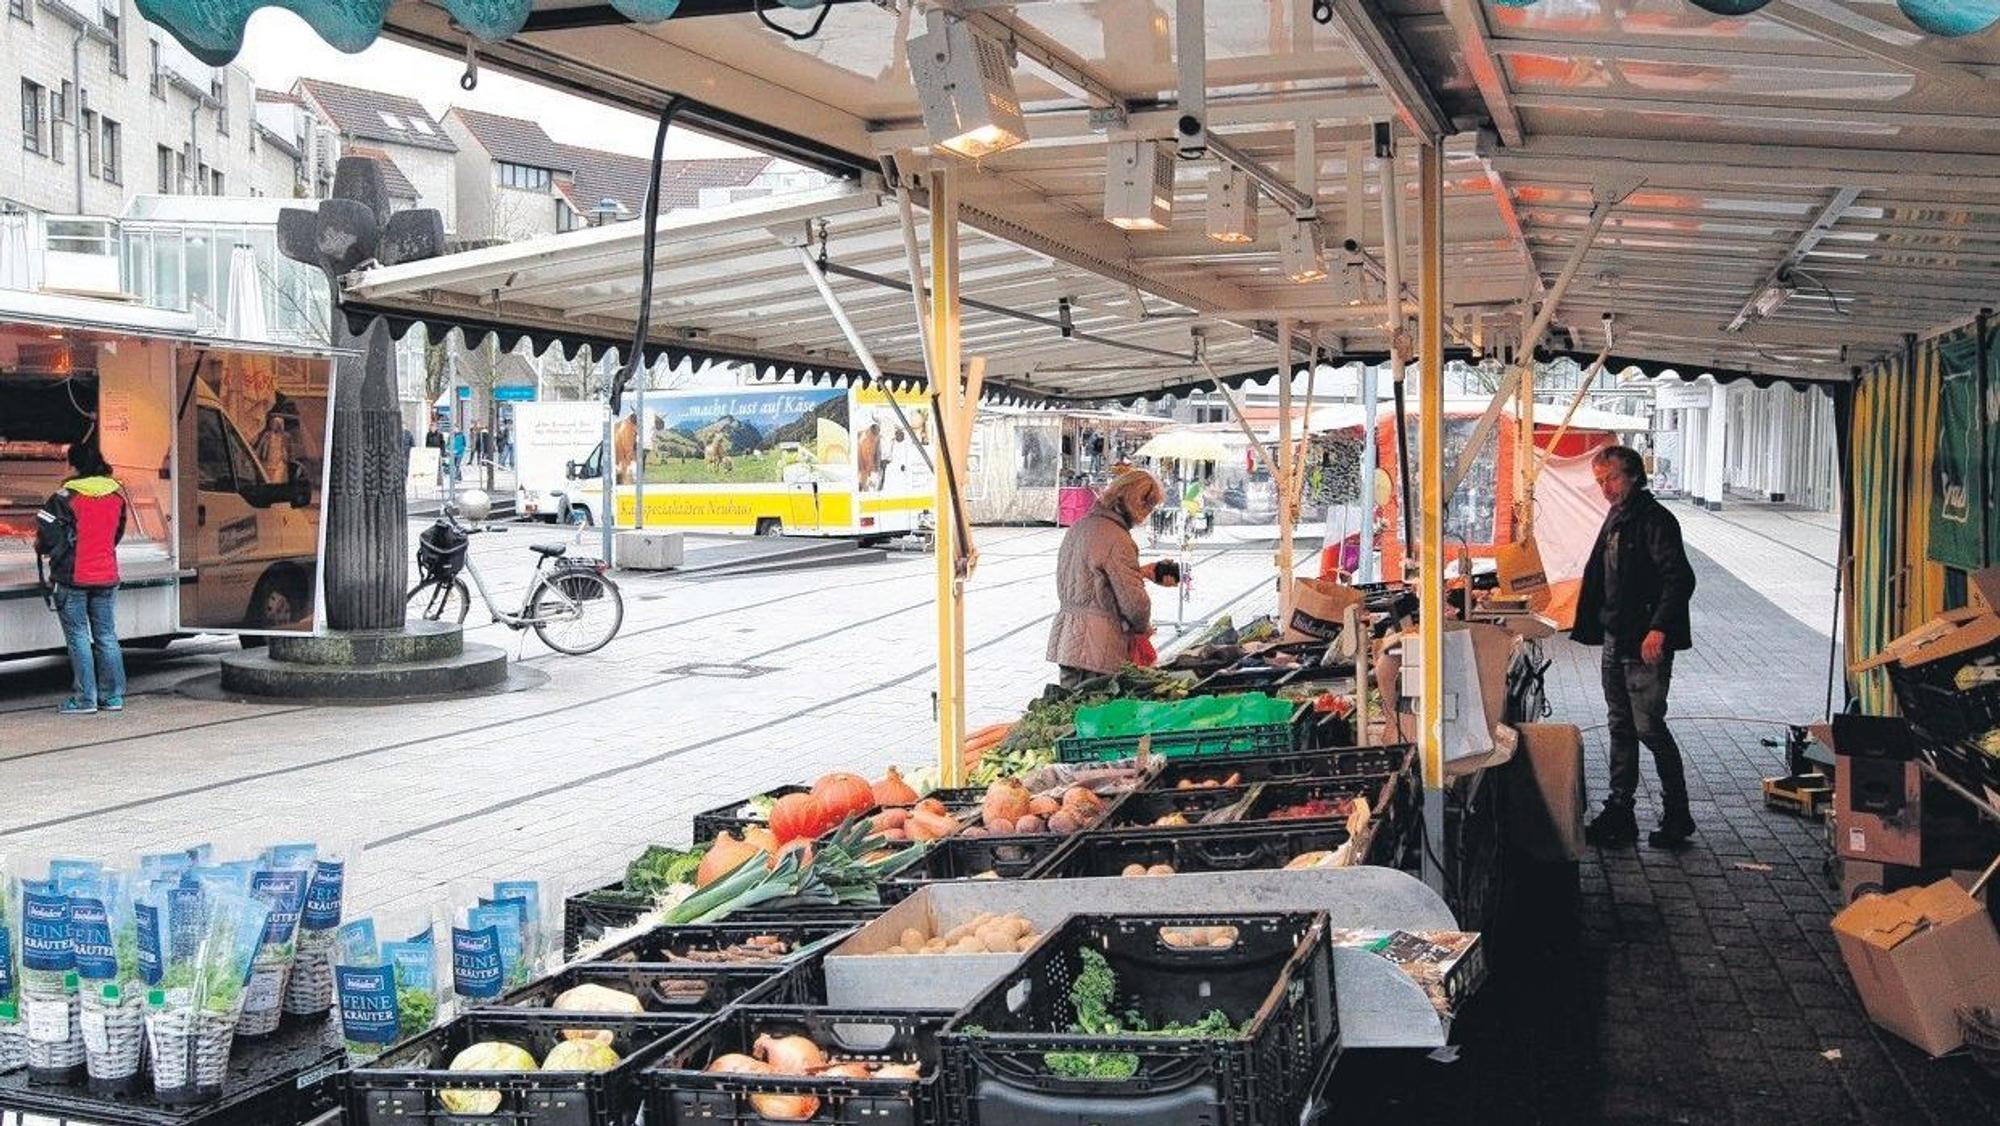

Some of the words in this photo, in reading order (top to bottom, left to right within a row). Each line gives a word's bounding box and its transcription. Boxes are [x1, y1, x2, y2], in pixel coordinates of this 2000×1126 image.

[729, 399, 757, 416] Lust
[759, 396, 783, 420] auf
[784, 394, 815, 413] Käse
[455, 953, 498, 969] FEINE
[455, 966, 500, 977] KRÄUTER
[343, 995, 393, 1011] FEINE
[343, 1010, 395, 1022] KRÄUTER
